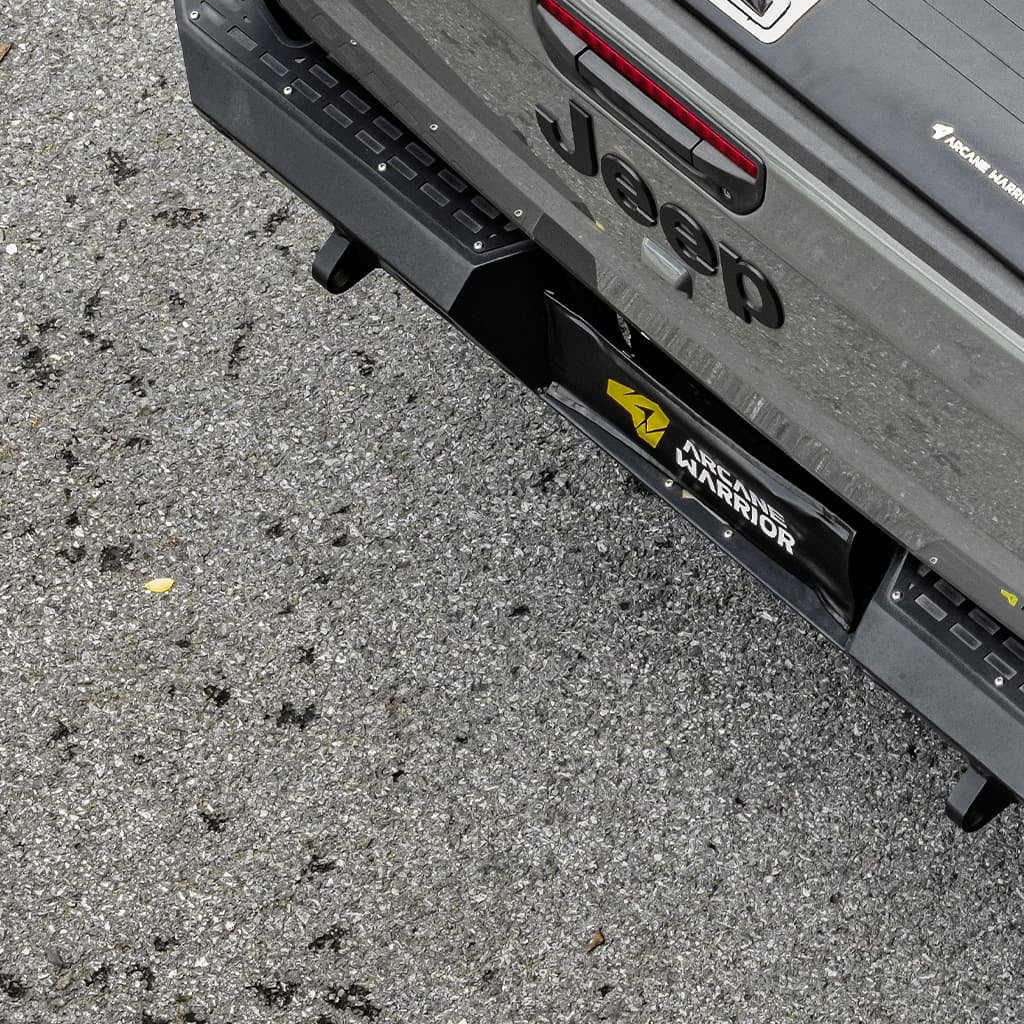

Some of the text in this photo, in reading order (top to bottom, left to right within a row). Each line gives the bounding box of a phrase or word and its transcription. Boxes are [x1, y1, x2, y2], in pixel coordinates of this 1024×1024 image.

[944, 135, 991, 174] ARCANE
[535, 98, 785, 330] Jeep
[675, 447, 796, 555] WARRIOR
[682, 439, 788, 528] ARCANE
